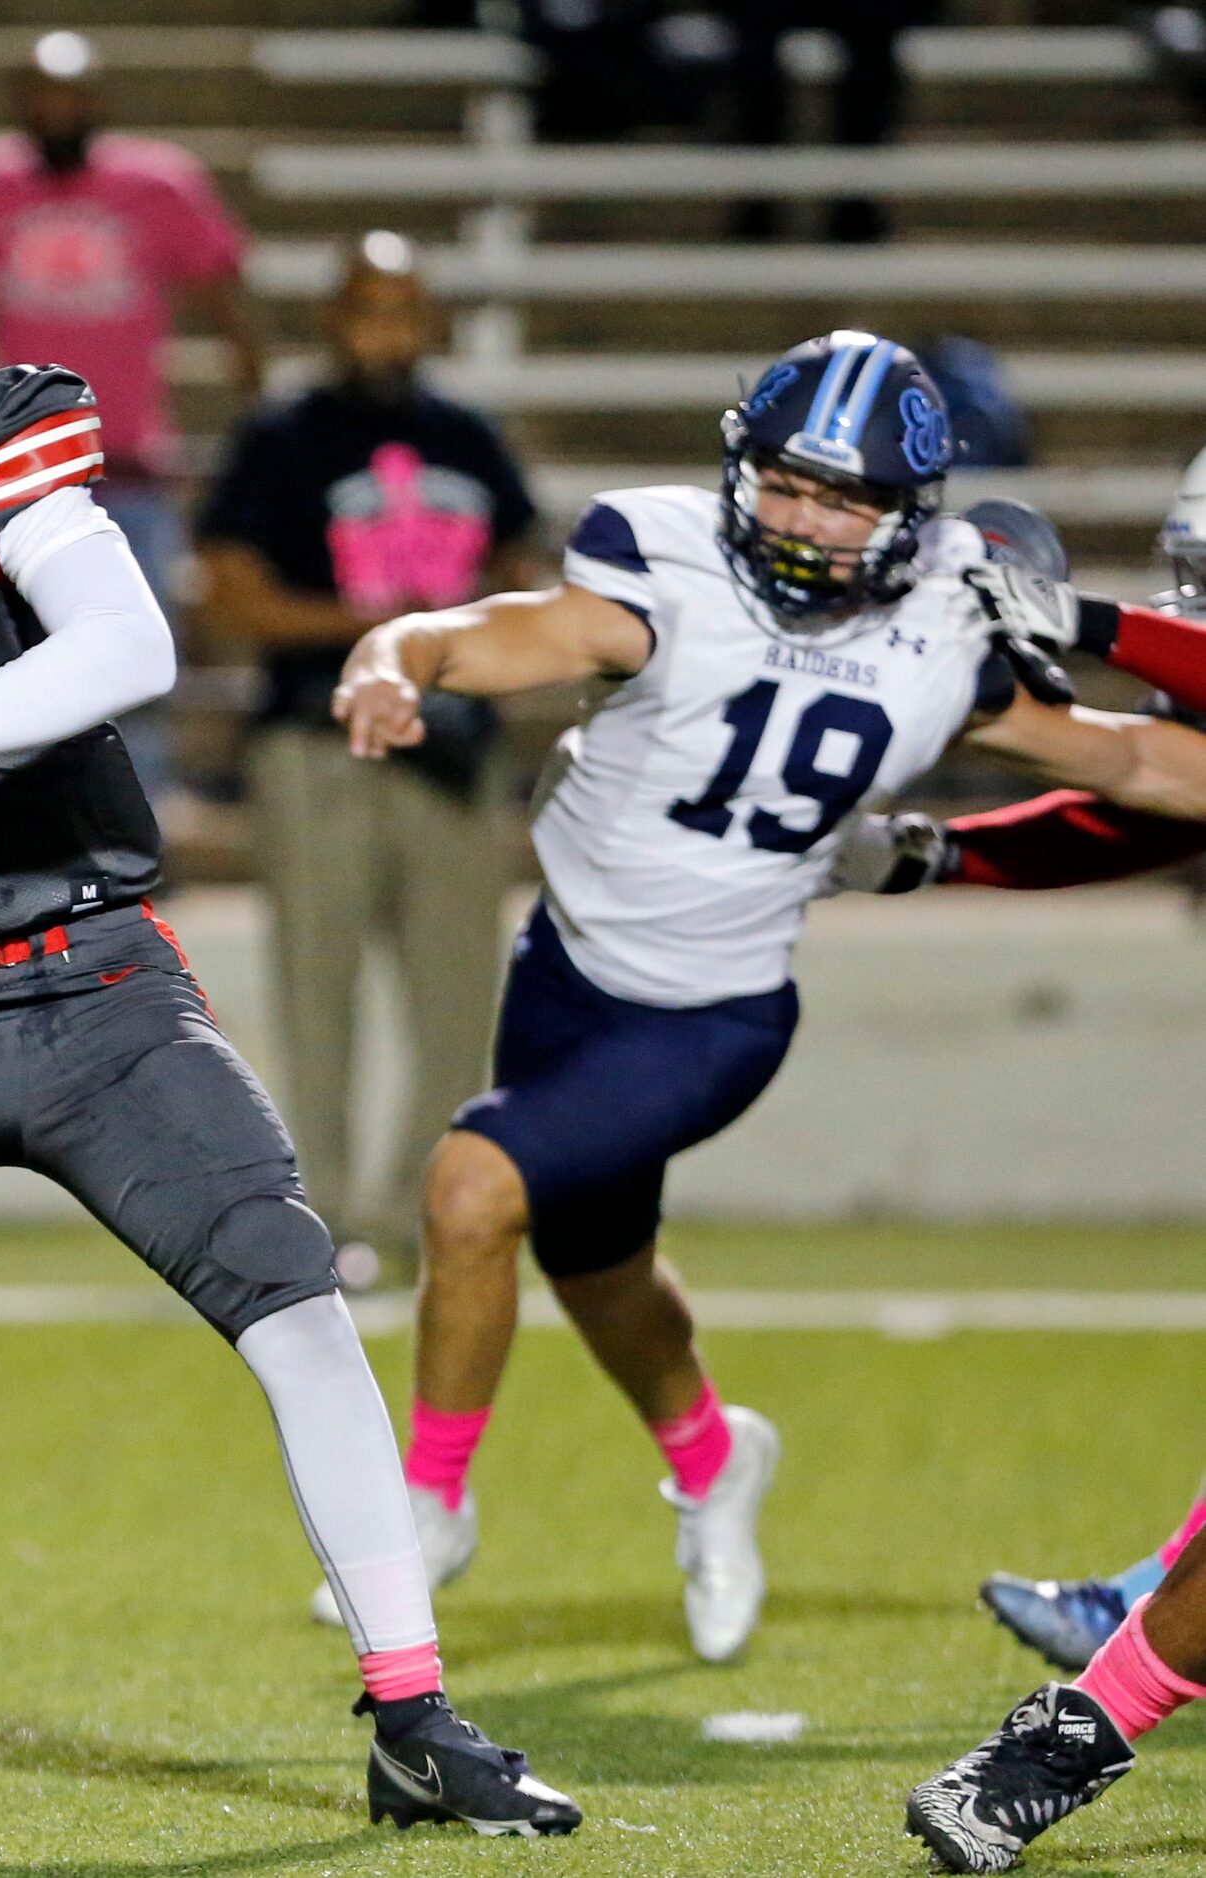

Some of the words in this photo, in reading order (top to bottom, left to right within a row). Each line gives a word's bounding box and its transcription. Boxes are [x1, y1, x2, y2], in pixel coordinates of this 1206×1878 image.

[763, 643, 878, 687] RAIDERS
[666, 679, 894, 853] 19
[81, 884, 98, 900] M
[1058, 1723, 1096, 1735] FORCE
